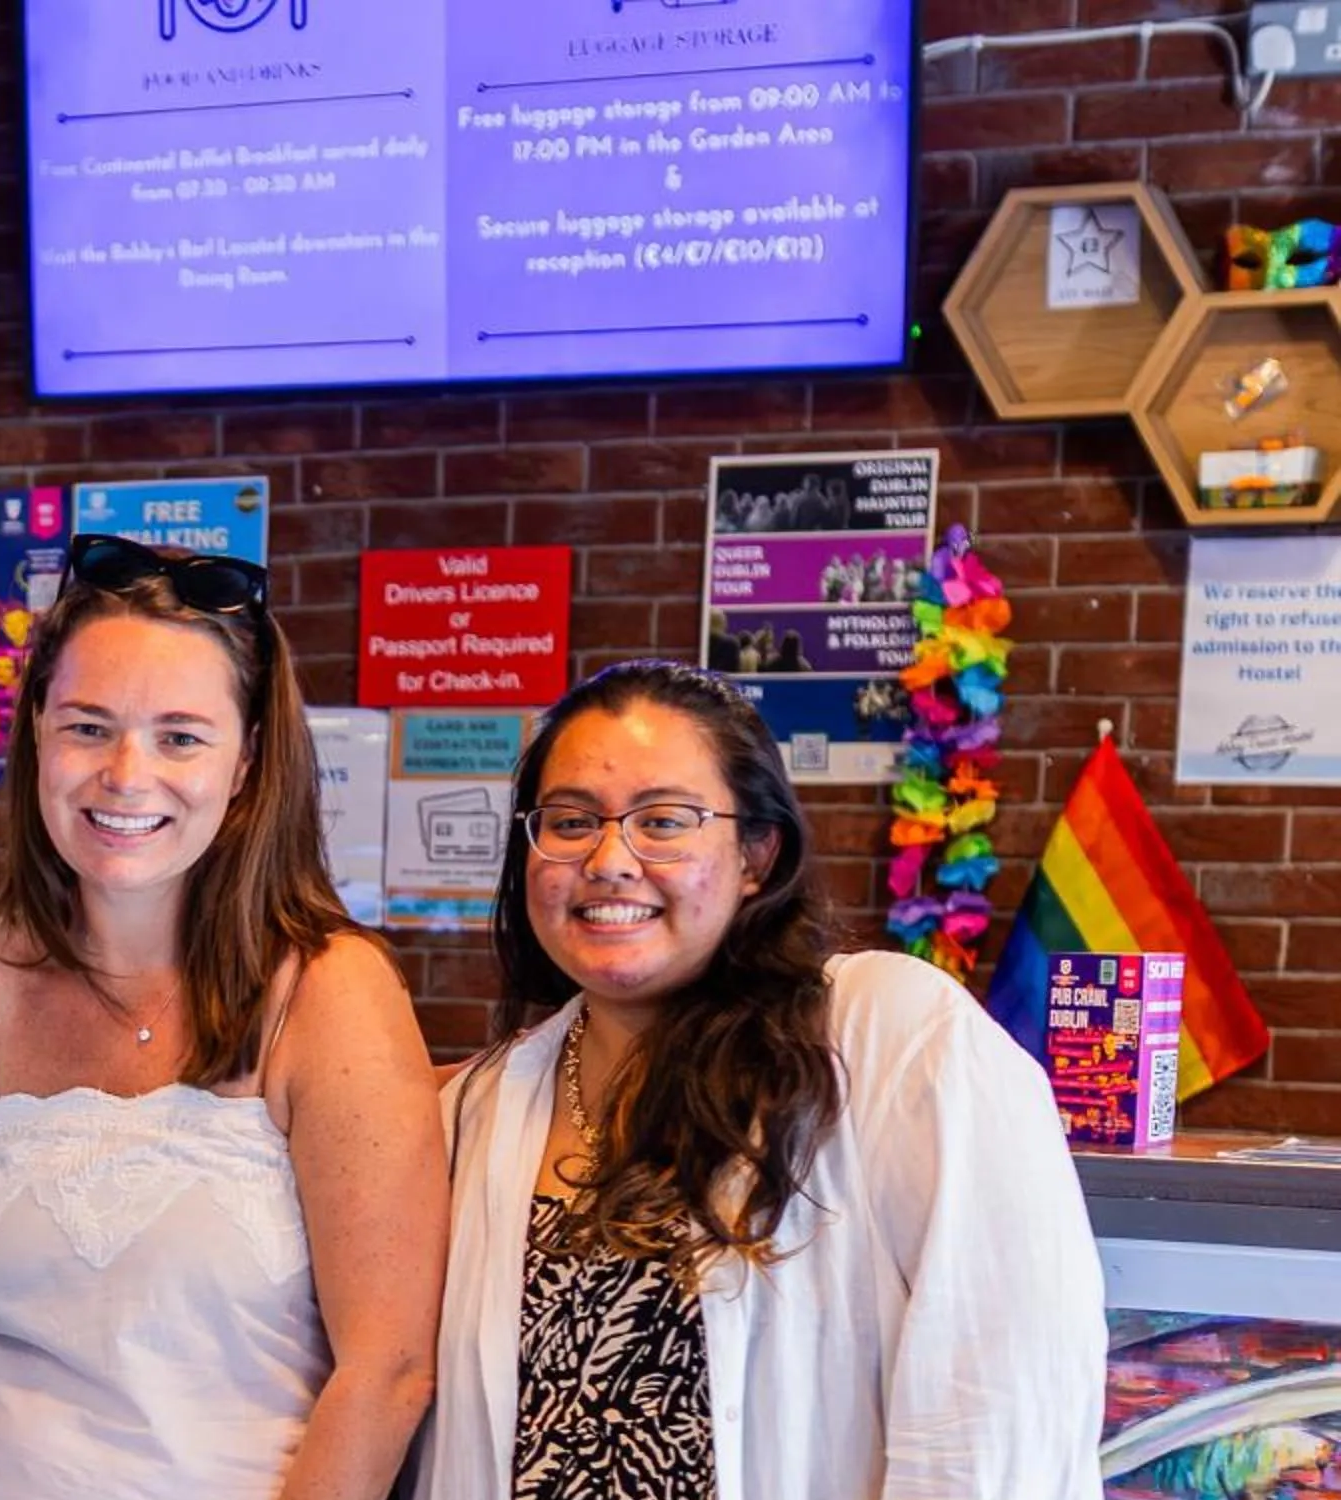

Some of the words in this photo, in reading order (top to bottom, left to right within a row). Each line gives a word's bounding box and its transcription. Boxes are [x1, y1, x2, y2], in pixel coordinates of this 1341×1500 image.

[674, 23, 779, 51] STORAGE
[458, 105, 506, 130] Free
[511, 103, 597, 131] luggage
[604, 97, 682, 124] storage
[690, 89, 743, 114] from
[748, 84, 820, 109] 09:00
[827, 80, 872, 103] AM
[513, 136, 570, 162] 17:00
[575, 134, 613, 158] PM
[619, 134, 642, 156] in
[647, 129, 683, 154] the
[690, 125, 771, 151] Garden
[778, 122, 834, 146] Area
[83, 150, 178, 176] Continental
[236, 143, 318, 167] Breakfast
[382, 134, 429, 158] daily
[302, 171, 337, 191] AM
[663, 164, 684, 191] &
[478, 214, 550, 239] Secure
[556, 210, 645, 239] luggage
[652, 206, 735, 233] storage
[743, 195, 846, 225] available
[853, 196, 880, 217] at
[218, 233, 287, 257] Located
[291, 230, 384, 253] downstairs
[409, 225, 441, 247] the
[526, 247, 627, 274] reception
[852, 458, 929, 478] ORIGINAL
[869, 477, 929, 495] DUBLIN
[142, 499, 204, 524] FREE
[855, 494, 928, 512] HAUNTED
[884, 512, 926, 529] TOUR
[713, 545, 765, 563] QUEER
[437, 553, 490, 577] Valid
[712, 562, 771, 580] DUBLIN
[383, 582, 457, 606] Drivers
[460, 580, 541, 602] Licence
[712, 580, 753, 596] TOUR
[1203, 582, 1234, 600] We
[1237, 584, 1311, 600] reserve
[448, 610, 473, 629] or
[1205, 610, 1250, 631] right
[1256, 611, 1275, 627] to
[368, 634, 458, 661] Passport
[461, 631, 555, 660] Required
[1192, 637, 1290, 655] admission
[1295, 639, 1315, 655] to
[1320, 637, 1341, 655] th
[396, 670, 426, 693] for
[1237, 664, 1302, 682] Hostel
[1050, 987, 1072, 1006] PUB
[1074, 987, 1110, 1008] CRAWL
[1048, 1009, 1090, 1029] DUBLIN
